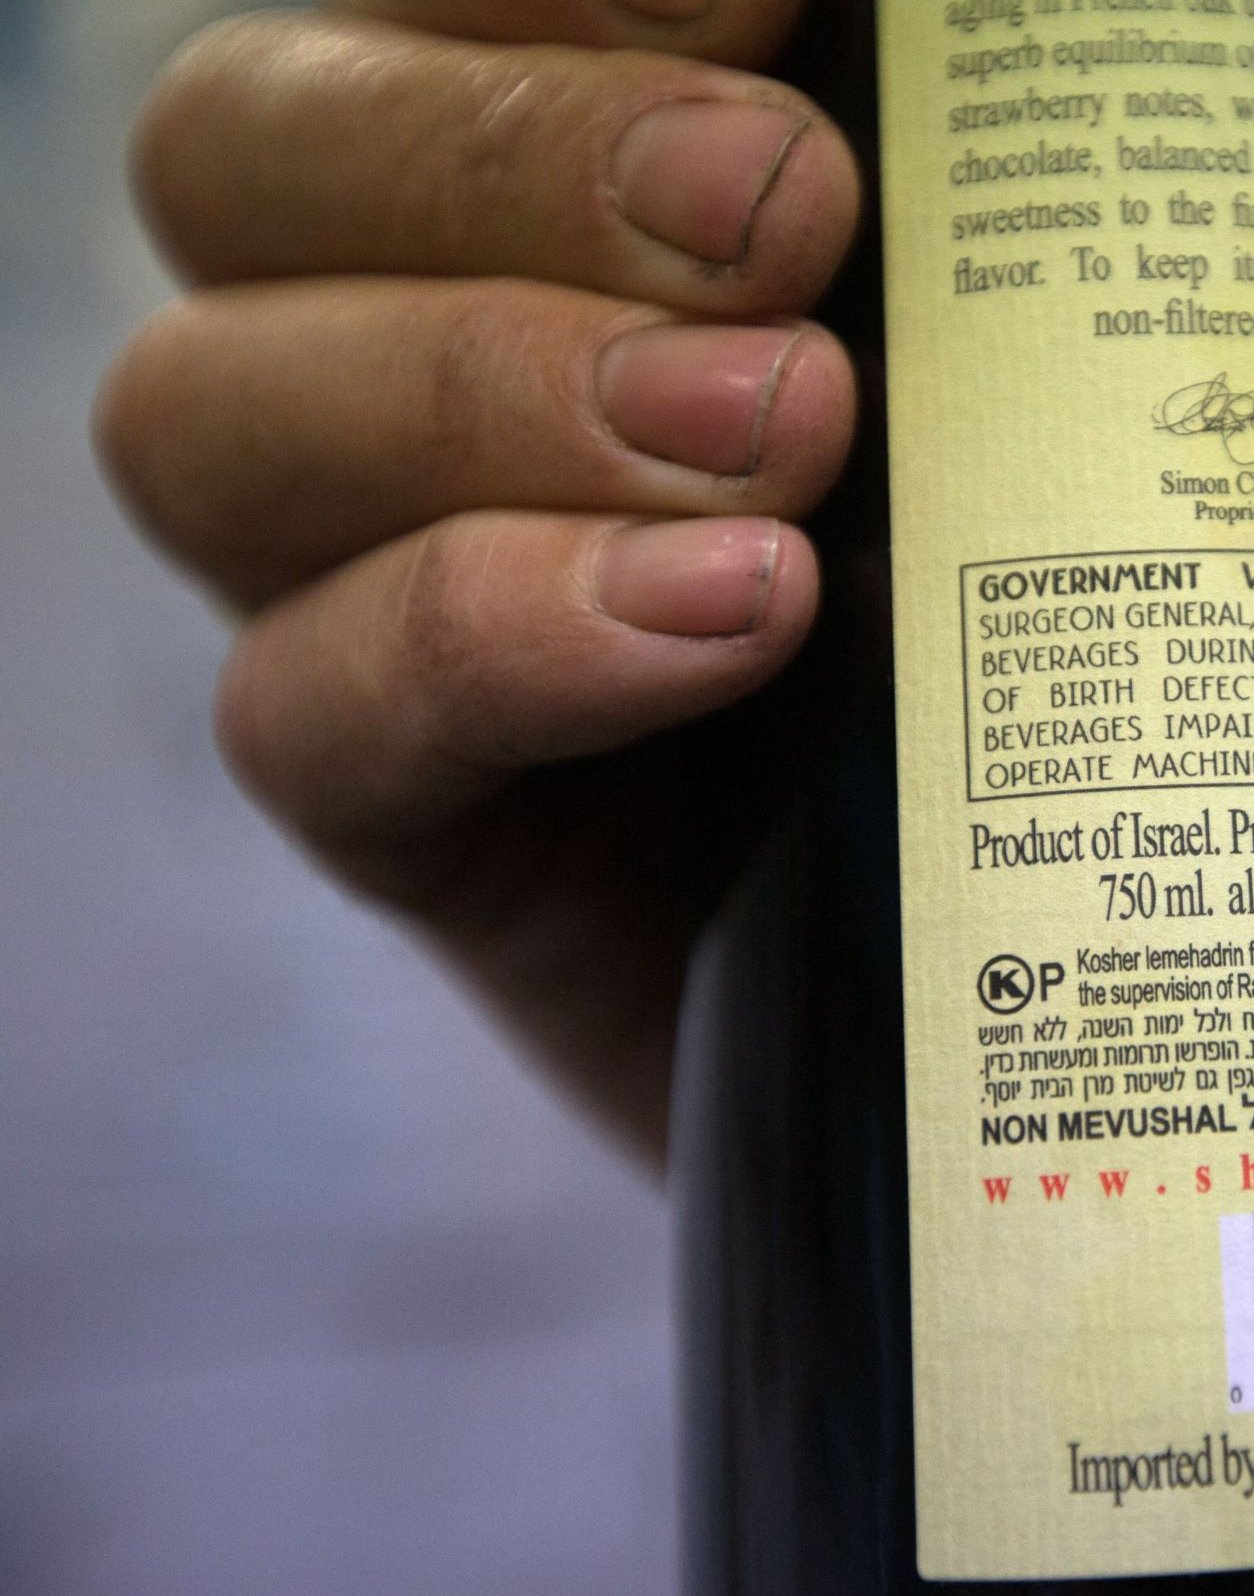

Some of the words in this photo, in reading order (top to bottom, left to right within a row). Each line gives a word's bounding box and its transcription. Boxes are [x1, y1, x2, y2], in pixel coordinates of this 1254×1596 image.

[947, 34, 1044, 84] superb
[1052, 28, 1227, 75] equilibrium
[949, 86, 1106, 132] strawberry
[1124, 88, 1214, 124] notes,
[951, 139, 1101, 186] chocolate,
[1117, 135, 1251, 174] balanced
[952, 199, 1101, 240] sweetness
[1119, 193, 1149, 225] to
[1168, 189, 1214, 226] the
[953, 256, 1046, 295] flavor.
[1070, 246, 1111, 282] To
[1136, 243, 1209, 290] keep
[1161, 470, 1230, 494] Simon
[979, 562, 1201, 602] GOVERNMENT
[980, 604, 1114, 639] SURGEON
[1125, 600, 1254, 631] GENERAL,
[981, 641, 1139, 677] BEVERAGES
[982, 686, 1021, 714] OF
[1050, 677, 1134, 708] BIRTH
[984, 715, 1142, 751] BEVERAGES
[985, 755, 1113, 789] OPERATE
[970, 817, 1084, 870] Product
[1091, 811, 1126, 861] of
[1131, 808, 1220, 858] Israel.
[1099, 871, 1157, 922] 750
[1164, 868, 1214, 918] ml.
[1077, 948, 1141, 974] Kosher
[1145, 942, 1244, 972] lemehadrin
[1039, 962, 1065, 1001] P
[1079, 981, 1106, 1007] the
[1111, 975, 1212, 1010] supervision
[1217, 974, 1233, 999] of
[979, 1023, 1023, 1046] חשש
[1033, 1015, 1067, 1042] ללא
[1076, 1017, 1133, 1043] השנה,
[1144, 1014, 1183, 1035] ימות
[1194, 1006, 1232, 1032] ולכל
[1018, 1046, 1098, 1071] ומעשרות
[1103, 1043, 1168, 1067] תרומות
[1176, 1040, 1239, 1063] הופרשו
[981, 1080, 1021, 1108] יוסף.
[1030, 1077, 1073, 1100] הבית
[1084, 1075, 1114, 1102] מרן
[1124, 1066, 1185, 1094] לשיטת
[1196, 1069, 1217, 1090] גם
[982, 1113, 1047, 1147] NON
[1058, 1103, 1237, 1142] MEVUSHAL
[1230, 1386, 1242, 1404] 0
[1067, 1433, 1214, 1507] Imported
